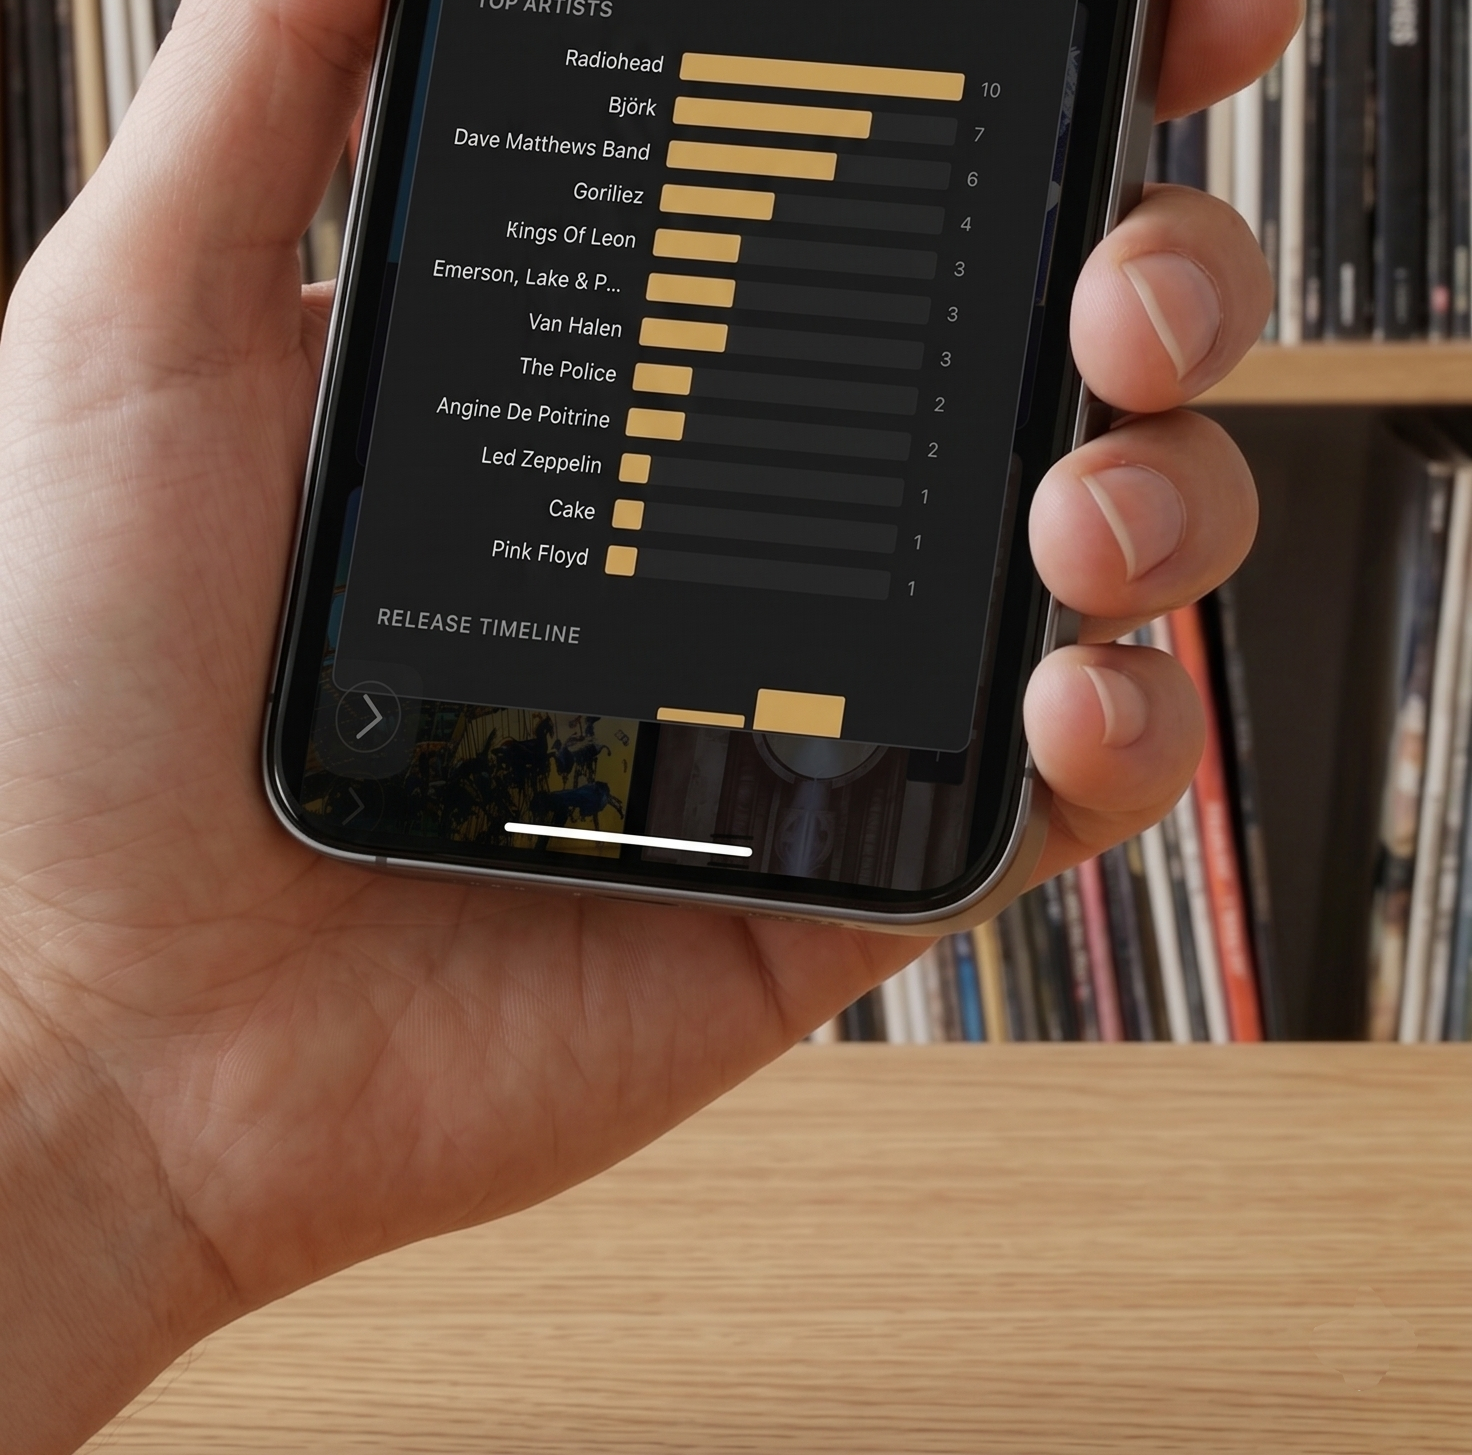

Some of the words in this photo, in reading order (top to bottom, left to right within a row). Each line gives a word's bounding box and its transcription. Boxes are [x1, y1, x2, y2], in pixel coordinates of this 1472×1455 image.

[565, 49, 665, 73] Radiohead
[981, 81, 1001, 99] 10
[608, 96, 657, 118] Björk
[454, 127, 501, 149] Dave
[505, 132, 597, 157] Matthews
[602, 140, 651, 161] Band
[973, 126, 986, 143] 7
[966, 171, 980, 187] 6
[959, 216, 973, 232] 4
[506, 220, 558, 245] Kings
[563, 225, 587, 244] Of
[590, 227, 636, 249] Leon
[433, 259, 519, 287] Emerson,
[525, 268, 570, 288] Lake
[574, 271, 589, 290] &
[952, 260, 967, 277] 3
[945, 306, 960, 323] 3
[529, 312, 563, 333] Van
[568, 316, 622, 338] Halen
[520, 356, 554, 377] The
[559, 360, 617, 383] Police
[939, 351, 953, 368] 3
[436, 396, 501, 421] Angine
[506, 402, 533, 422] De
[537, 405, 610, 429] Poitrine
[932, 396, 947, 413] 2
[926, 441, 940, 458] 2
[481, 446, 517, 466] Led
[520, 449, 602, 474] Zeppelin
[920, 488, 930, 505] 1
[549, 498, 596, 520] Cake
[913, 534, 923, 550] 1
[491, 539, 533, 561] Pink
[537, 544, 589, 569] Floyd
[906, 580, 916, 597] 1
[377, 607, 472, 634] RELEASE
[479, 617, 581, 644] TIMELINE
